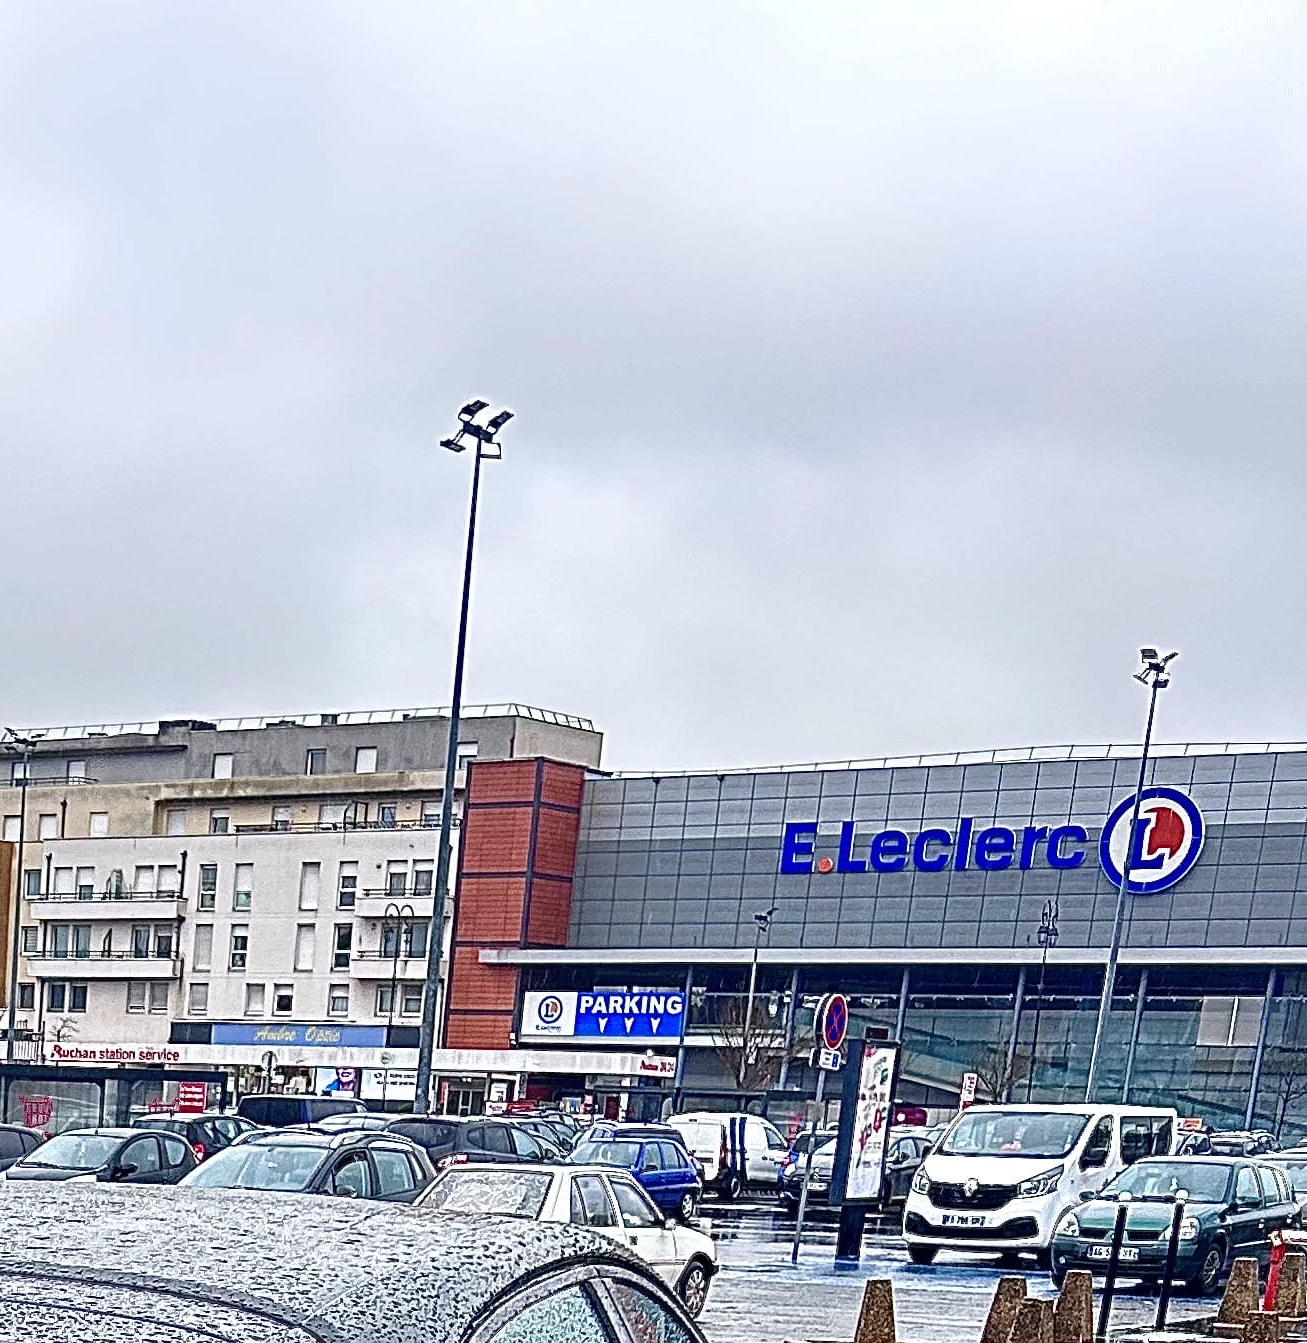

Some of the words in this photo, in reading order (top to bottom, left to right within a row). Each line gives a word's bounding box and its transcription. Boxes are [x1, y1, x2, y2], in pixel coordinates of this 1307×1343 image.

[780, 816, 1090, 875] E.Leclerc
[579, 995, 683, 1015] PARKING
[99, 1047, 135, 1060] station
[138, 1048, 180, 1061] service
